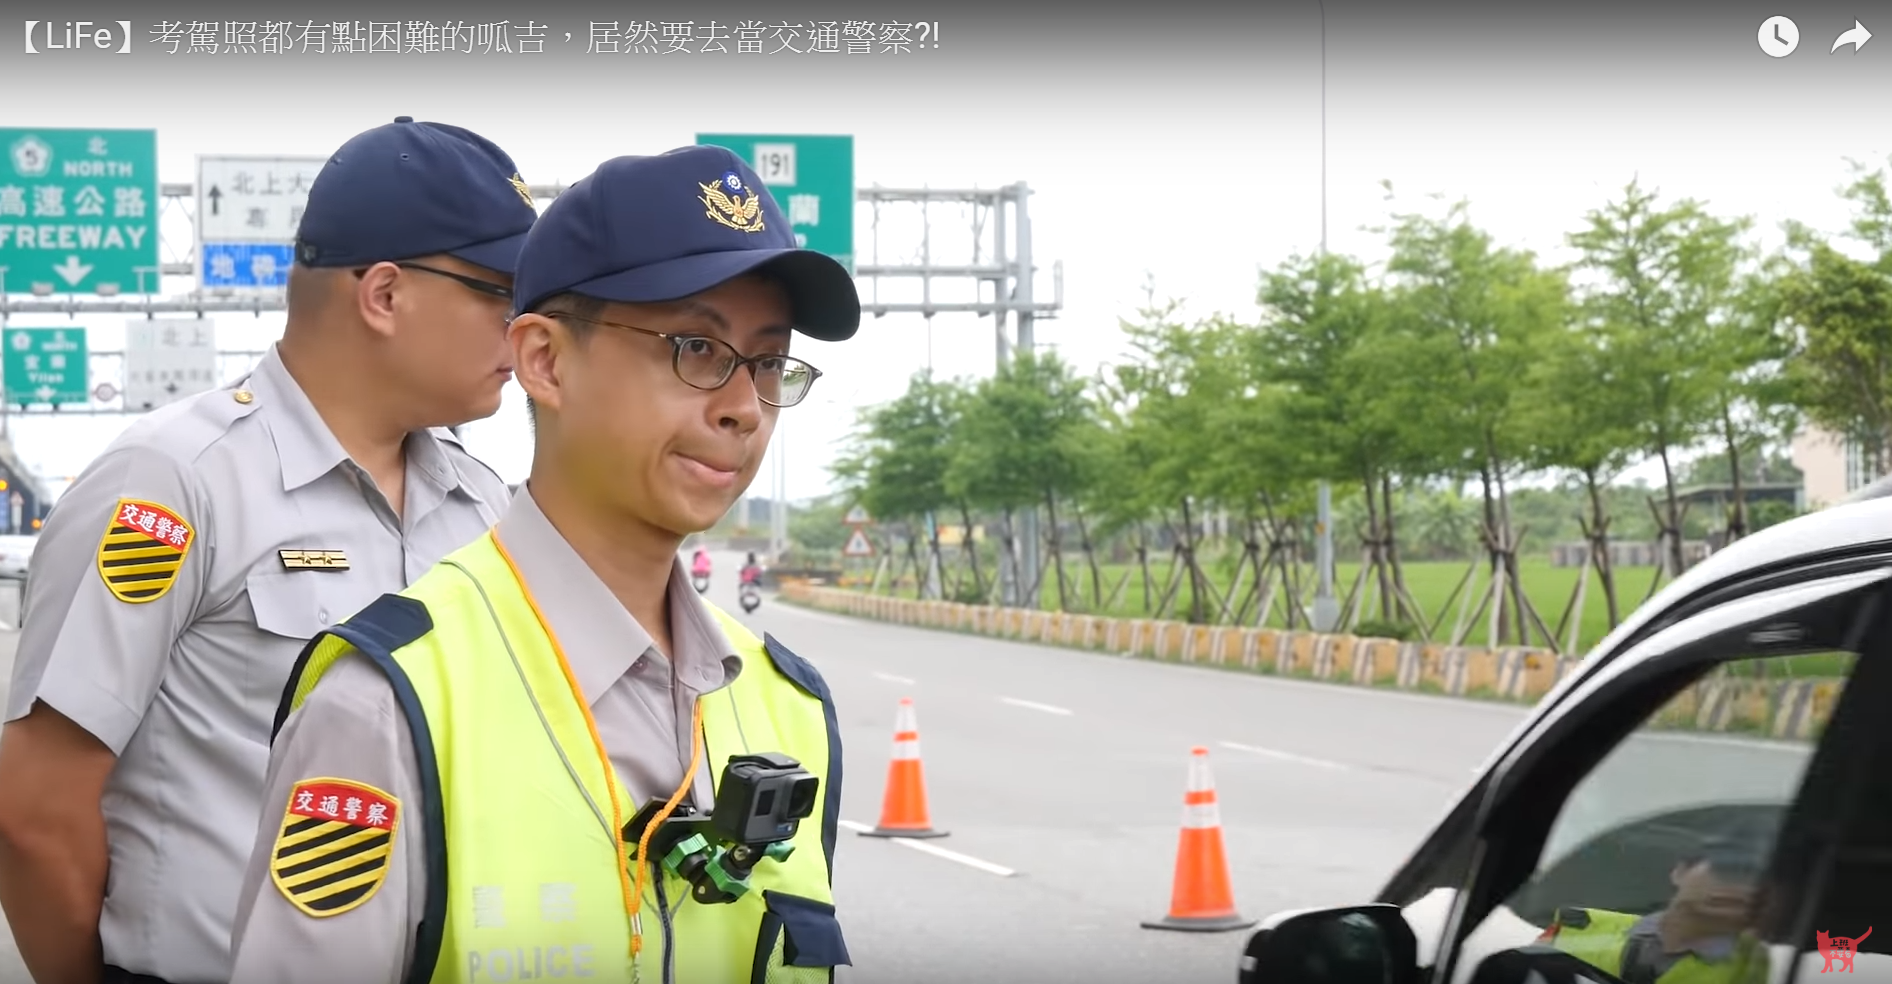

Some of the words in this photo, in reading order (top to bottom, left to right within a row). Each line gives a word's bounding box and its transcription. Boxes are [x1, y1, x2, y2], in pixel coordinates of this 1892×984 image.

[24, 149, 39, 166] 5
[63, 160, 133, 177] NORTH
[761, 153, 789, 176] 191
[0, 183, 147, 217] 高速公路
[0, 224, 147, 249] FREEWAY
[119, 503, 189, 545] 交通警察
[295, 790, 390, 826] 交通警察
[467, 944, 596, 984] POLICE
